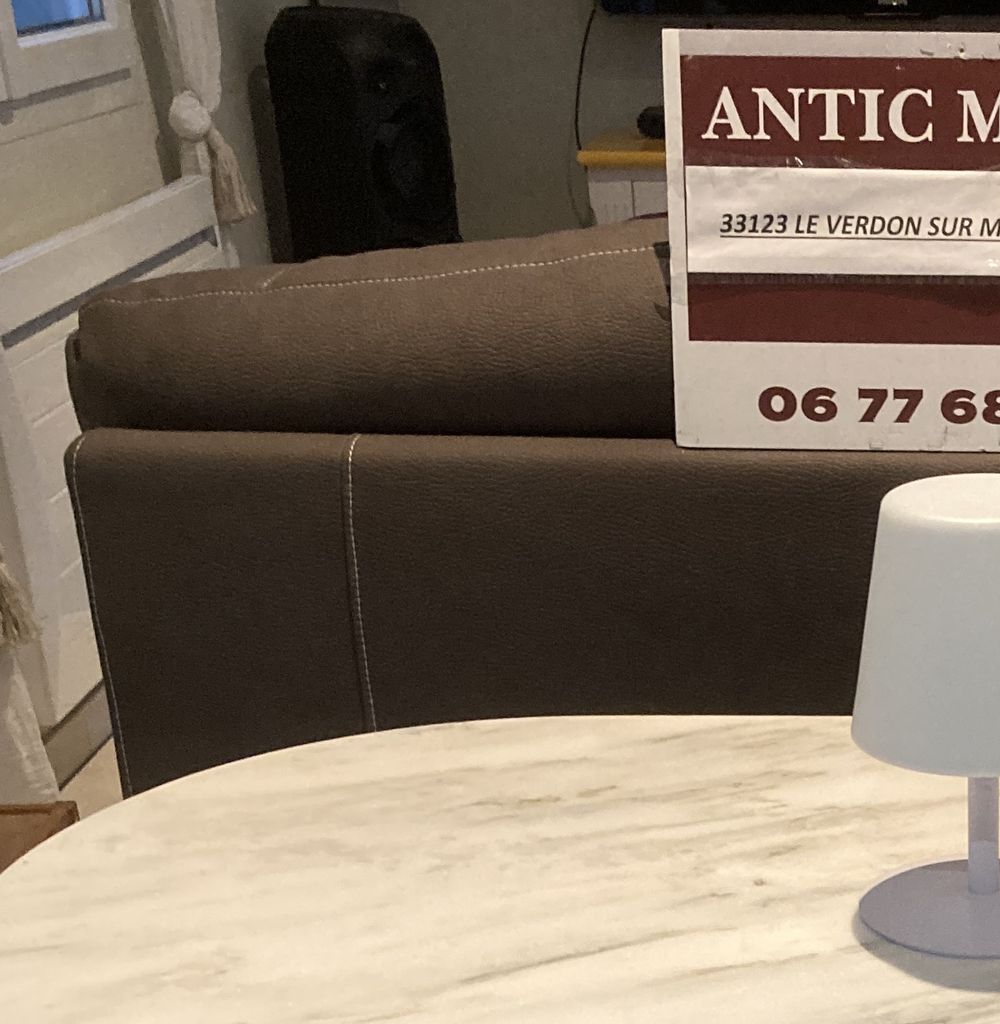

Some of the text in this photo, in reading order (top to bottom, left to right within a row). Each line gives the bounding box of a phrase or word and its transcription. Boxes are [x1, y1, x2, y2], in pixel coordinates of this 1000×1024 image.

[702, 86, 933, 143] ANTIC
[720, 213, 788, 234] 33123
[795, 214, 820, 235] LE
[826, 215, 922, 236] VERDON
[928, 217, 973, 237] SUR
[758, 386, 838, 423] 06
[857, 387, 924, 424] 77
